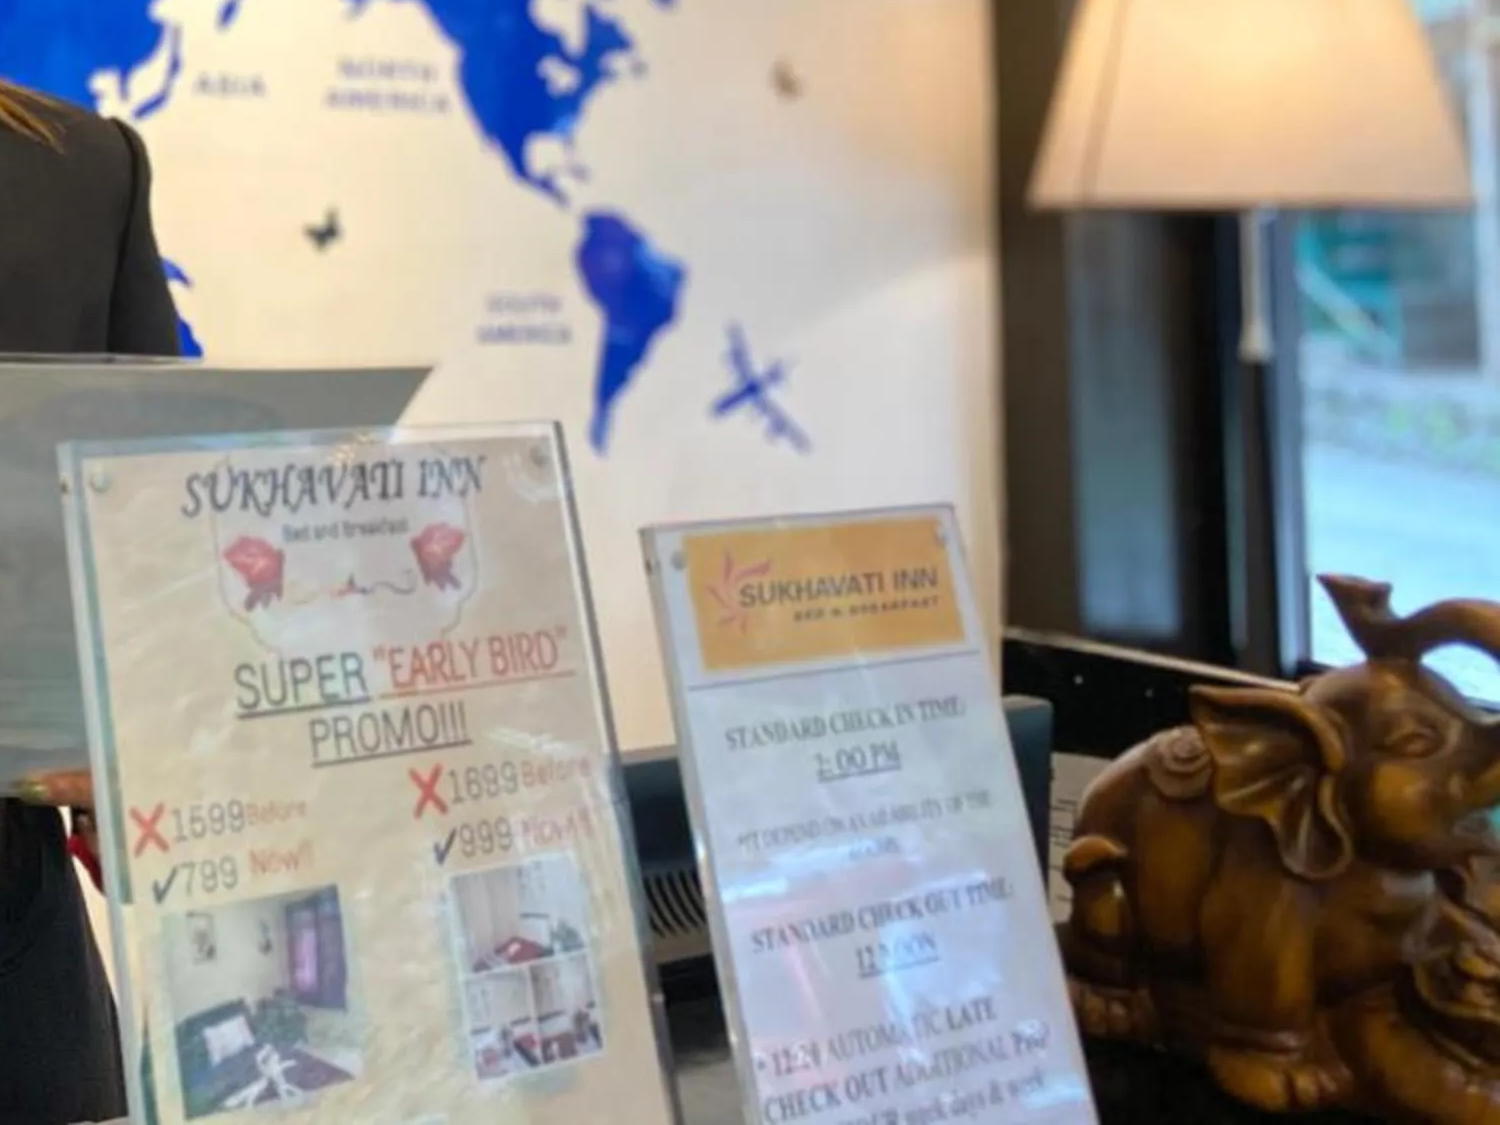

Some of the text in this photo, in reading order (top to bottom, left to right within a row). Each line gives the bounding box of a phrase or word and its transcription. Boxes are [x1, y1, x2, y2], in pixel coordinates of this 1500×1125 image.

[181, 455, 488, 518] SUKHAVATI INN
[739, 565, 939, 608] SUKHAVATI INN
[234, 651, 370, 711] SUPER
[308, 698, 470, 761] PROMO!!!
[724, 714, 828, 751] STANDARD
[828, 706, 895, 736] CHECK
[894, 702, 916, 726] IN
[869, 739, 901, 771] PM
[171, 799, 245, 844] 1599
[459, 816, 514, 859] 999
[179, 855, 239, 895] 799
[752, 909, 856, 954] STANDARD
[857, 896, 924, 933] CHECK
[924, 887, 962, 916] OUT
[856, 943, 879, 975] 12
[945, 995, 998, 1031] LATE
[765, 1081, 843, 1125] CHECK
[844, 1066, 888, 1103] OUT
